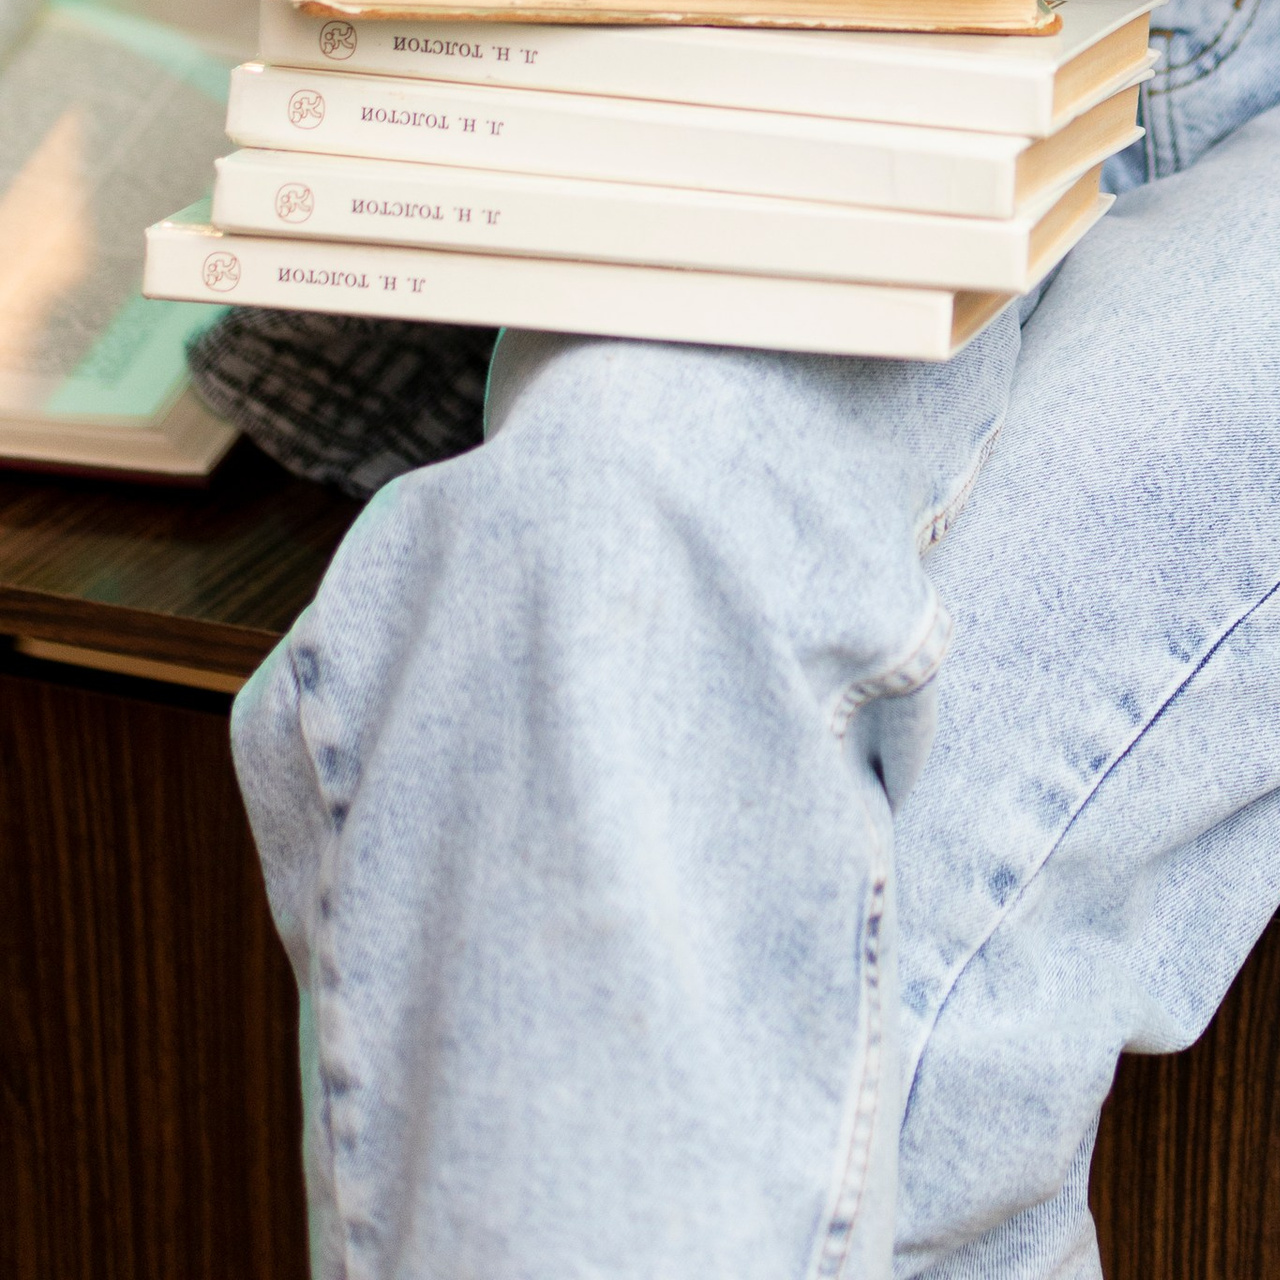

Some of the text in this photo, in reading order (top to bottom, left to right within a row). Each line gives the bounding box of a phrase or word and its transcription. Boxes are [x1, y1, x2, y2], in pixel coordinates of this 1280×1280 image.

[492, 46, 511, 60] Н.
[520, 49, 539, 64] Л.
[459, 117, 476, 132] Н.
[486, 120, 504, 135] Л.
[454, 208, 471, 222] Н.
[482, 210, 501, 224] Л.
[379, 276, 397, 291] Н.
[407, 278, 426, 293] Л.
